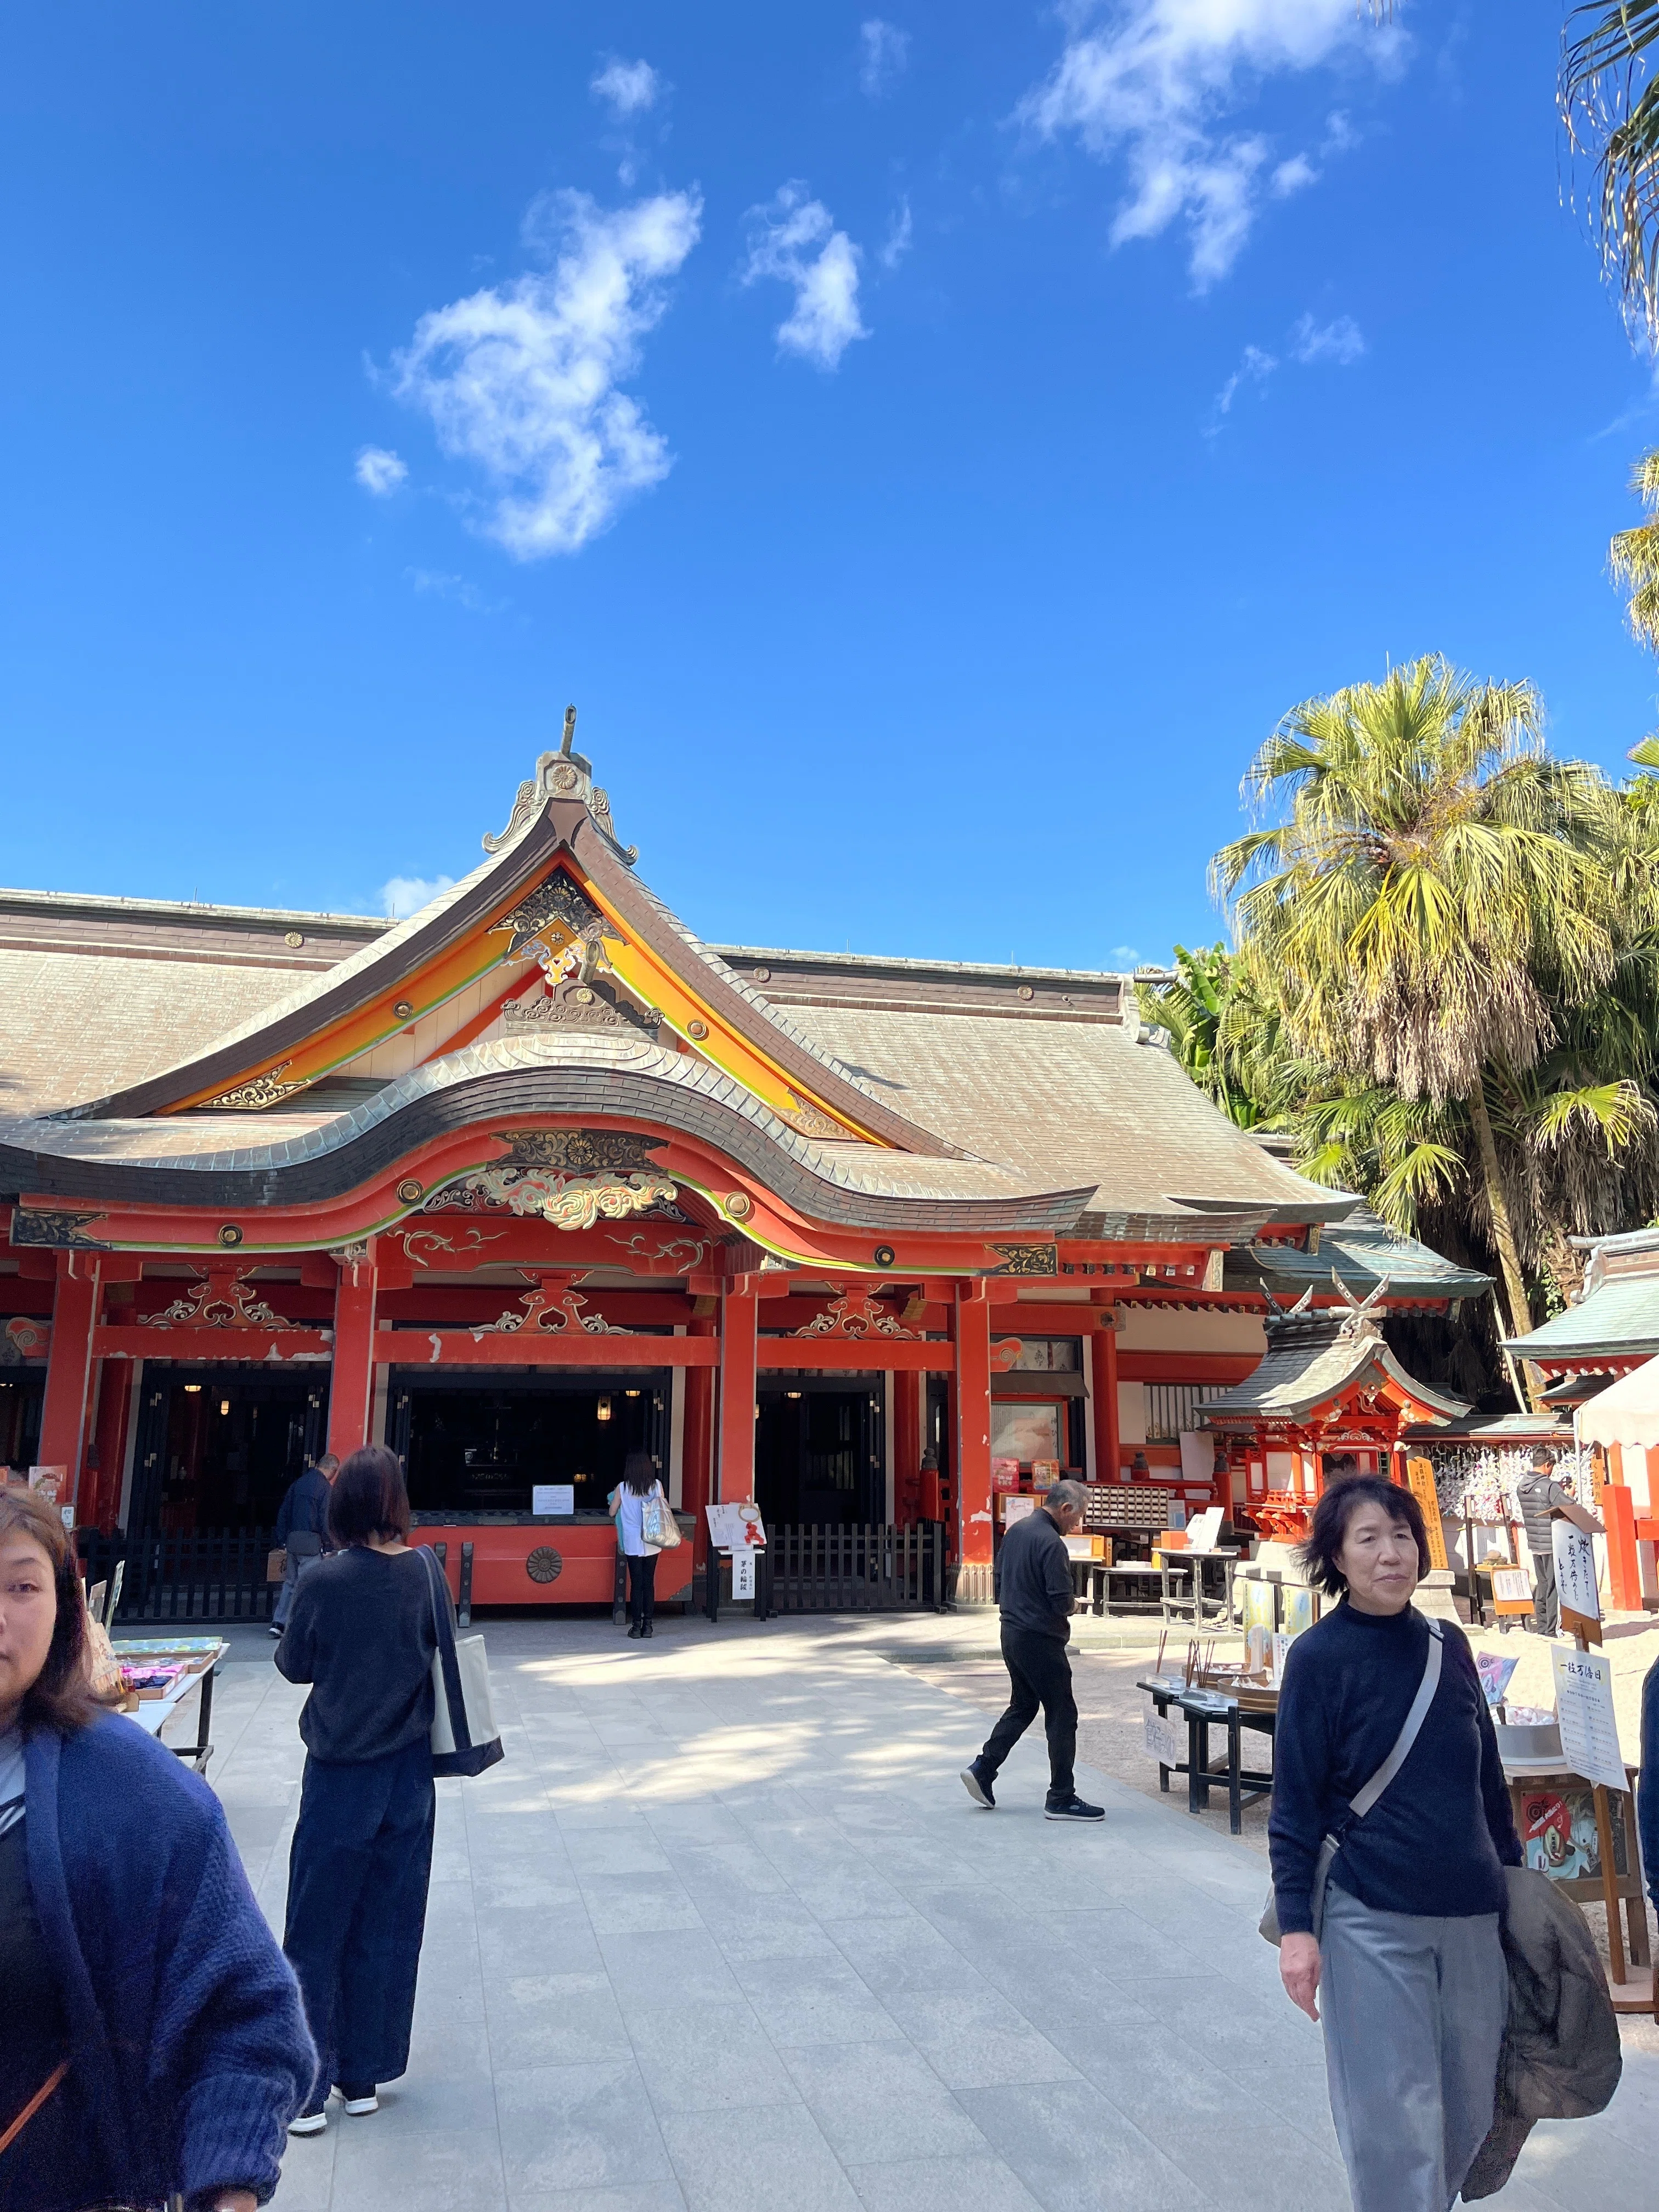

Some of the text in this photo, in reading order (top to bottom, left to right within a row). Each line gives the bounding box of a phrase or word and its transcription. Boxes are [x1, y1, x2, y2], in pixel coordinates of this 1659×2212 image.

[1560, 1661, 1601, 1681] 一粒万倍日
